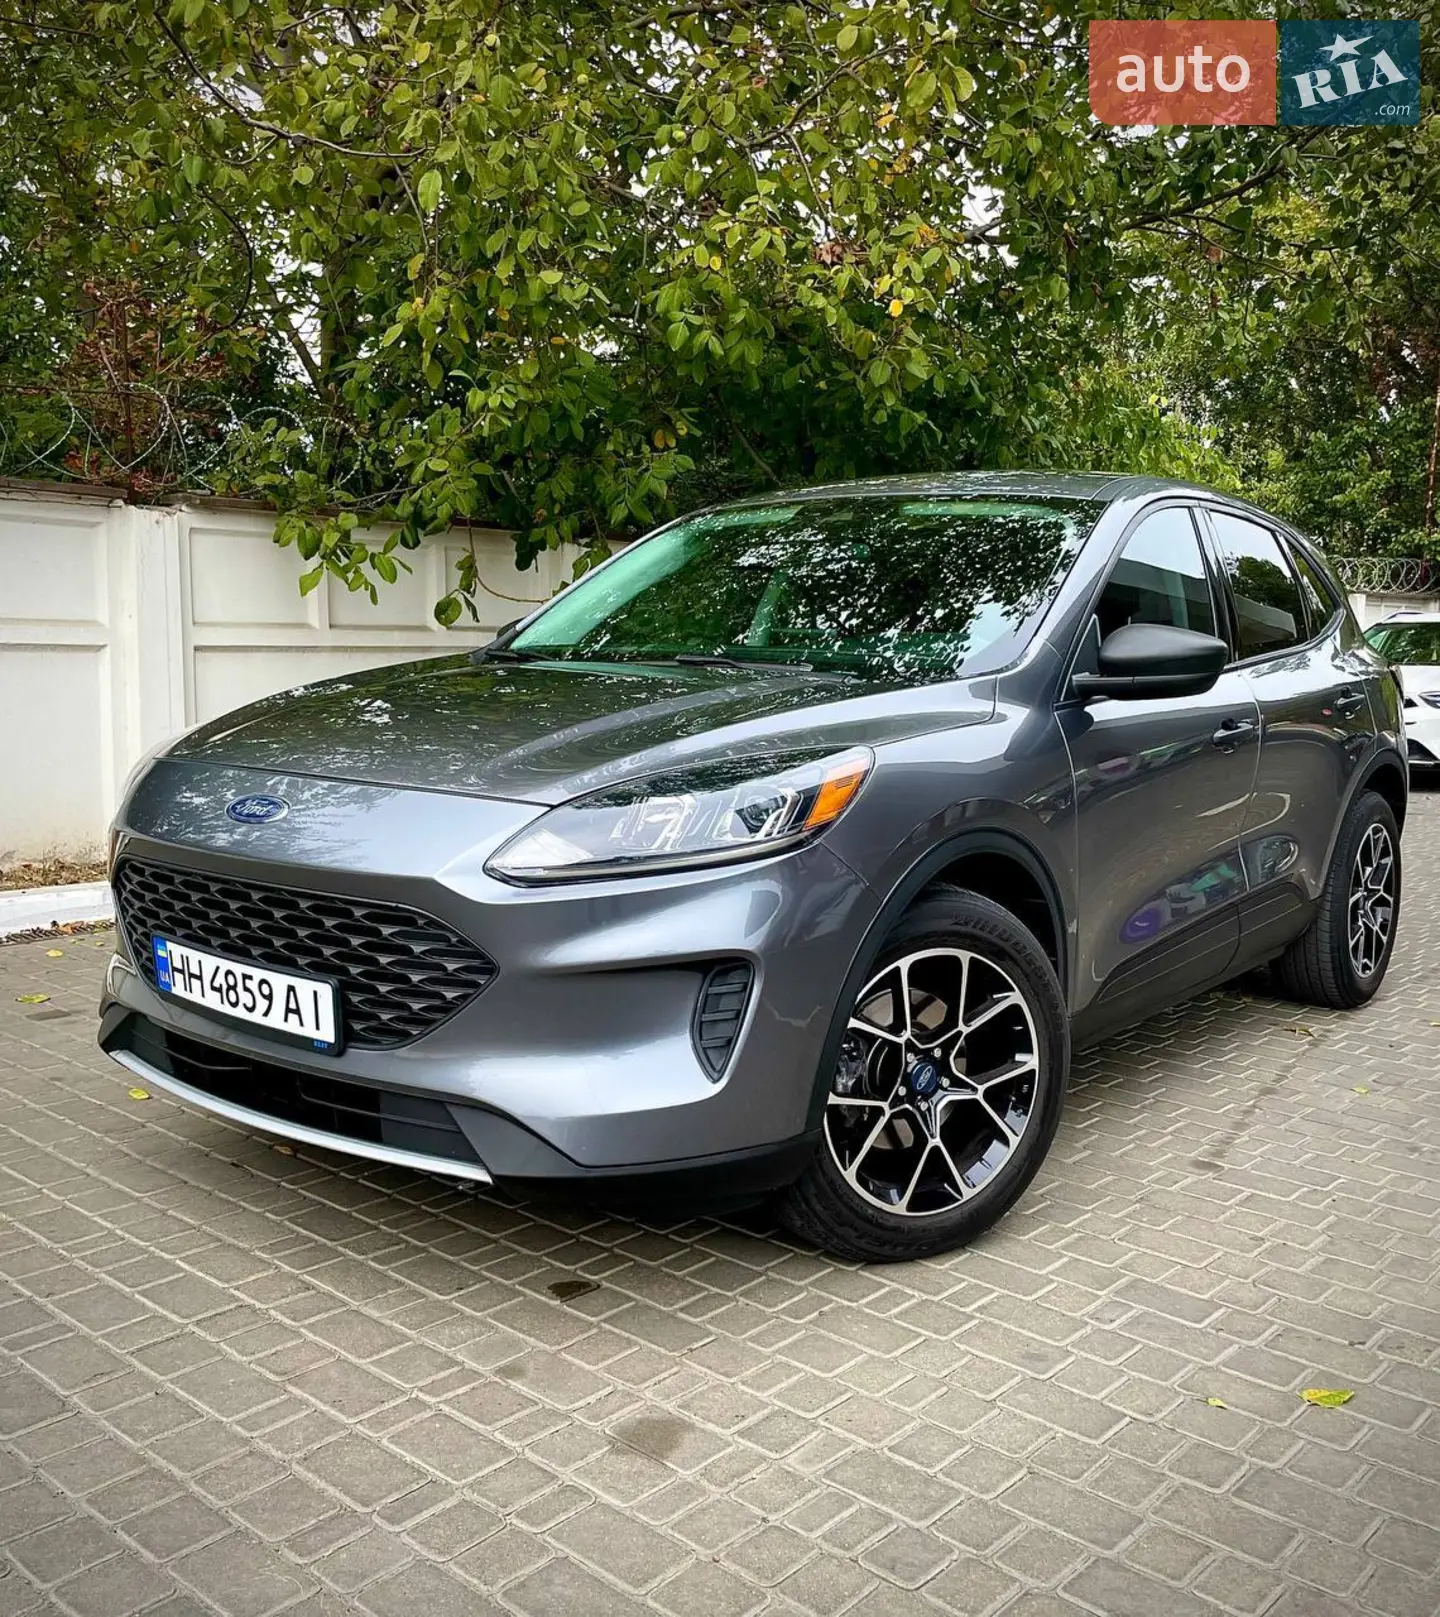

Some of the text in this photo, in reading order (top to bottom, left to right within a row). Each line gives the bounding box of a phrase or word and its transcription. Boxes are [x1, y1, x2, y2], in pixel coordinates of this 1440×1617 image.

[235, 799, 274, 815] Ford
[169, 950, 205, 998] HH
[210, 965, 273, 1018] 4859
